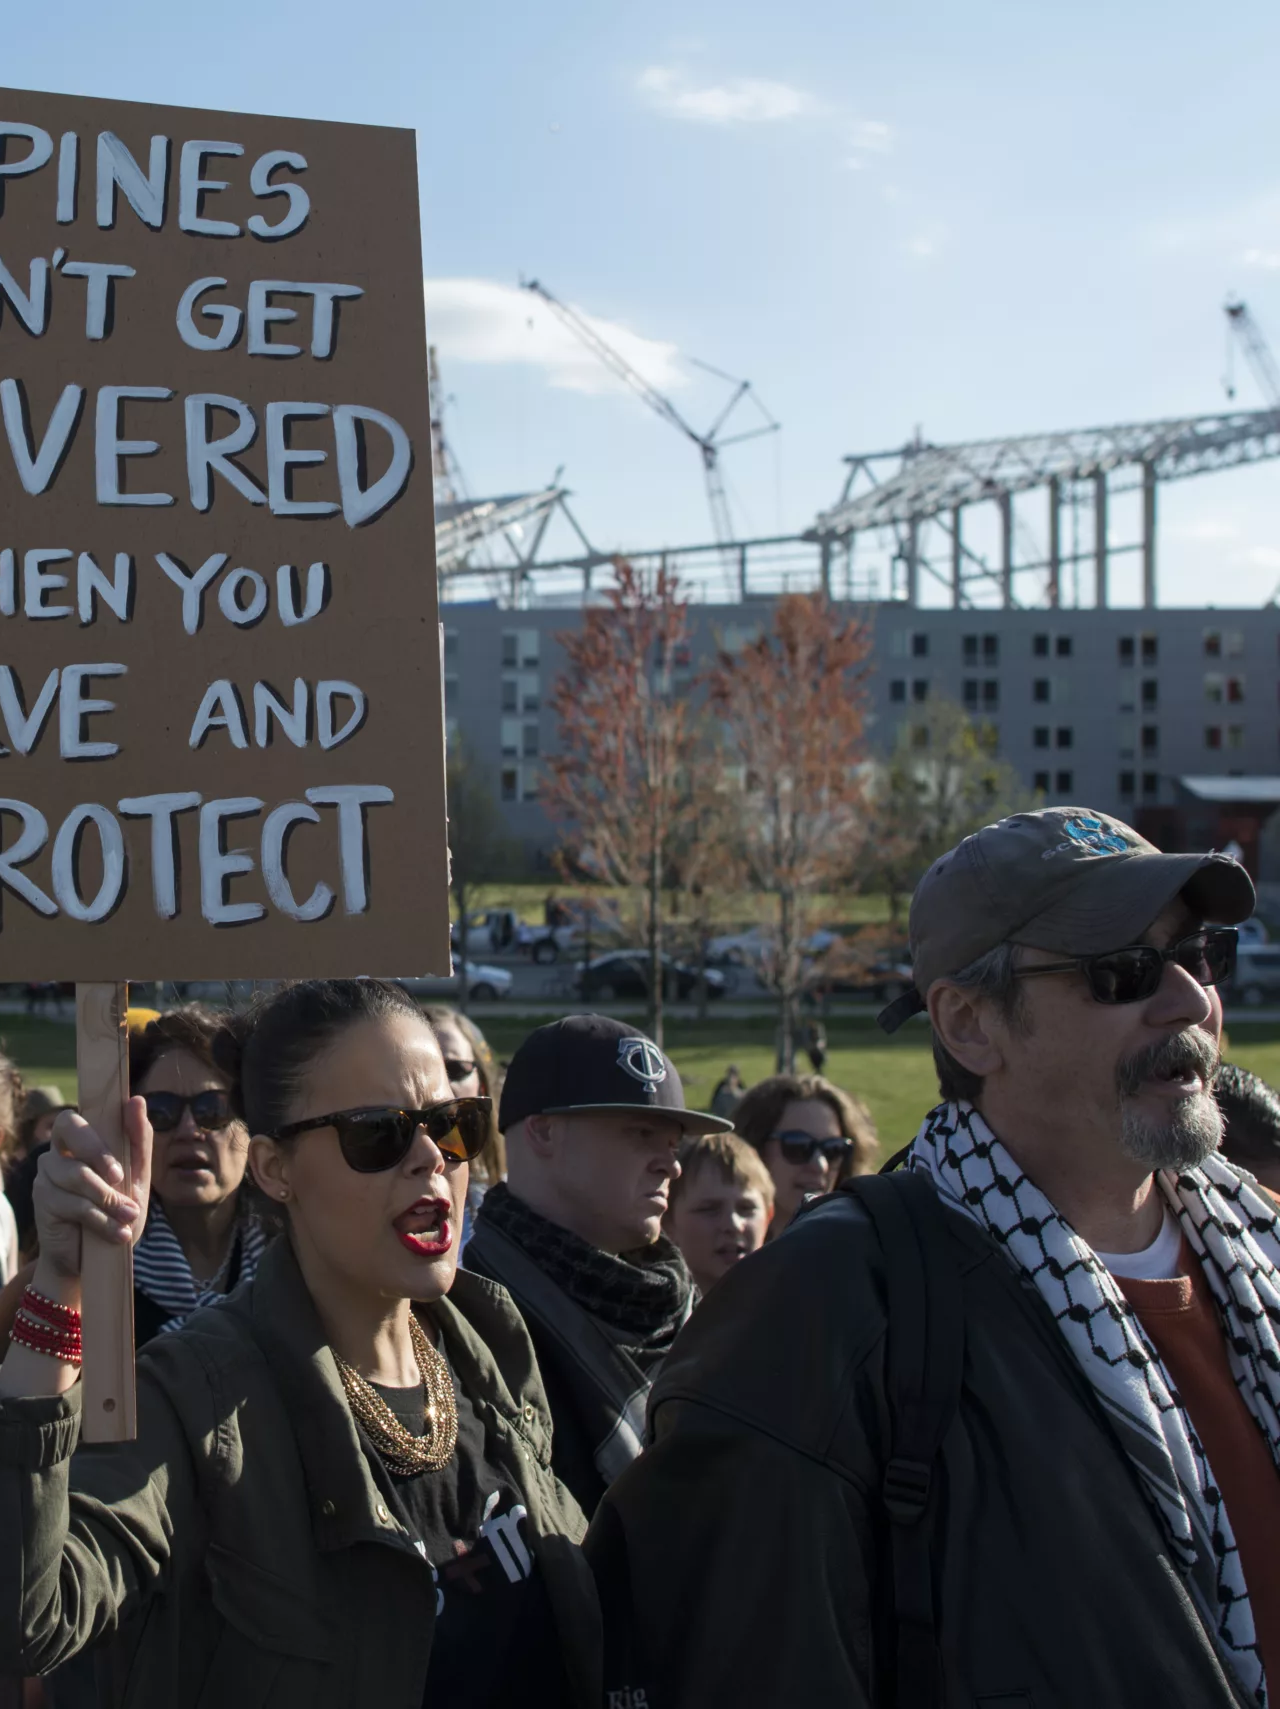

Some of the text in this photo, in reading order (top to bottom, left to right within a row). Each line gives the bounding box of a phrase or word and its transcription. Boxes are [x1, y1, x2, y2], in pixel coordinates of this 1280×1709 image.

[175, 276, 365, 359] GET
[154, 552, 326, 636] YOU
[188, 676, 365, 751] AND
